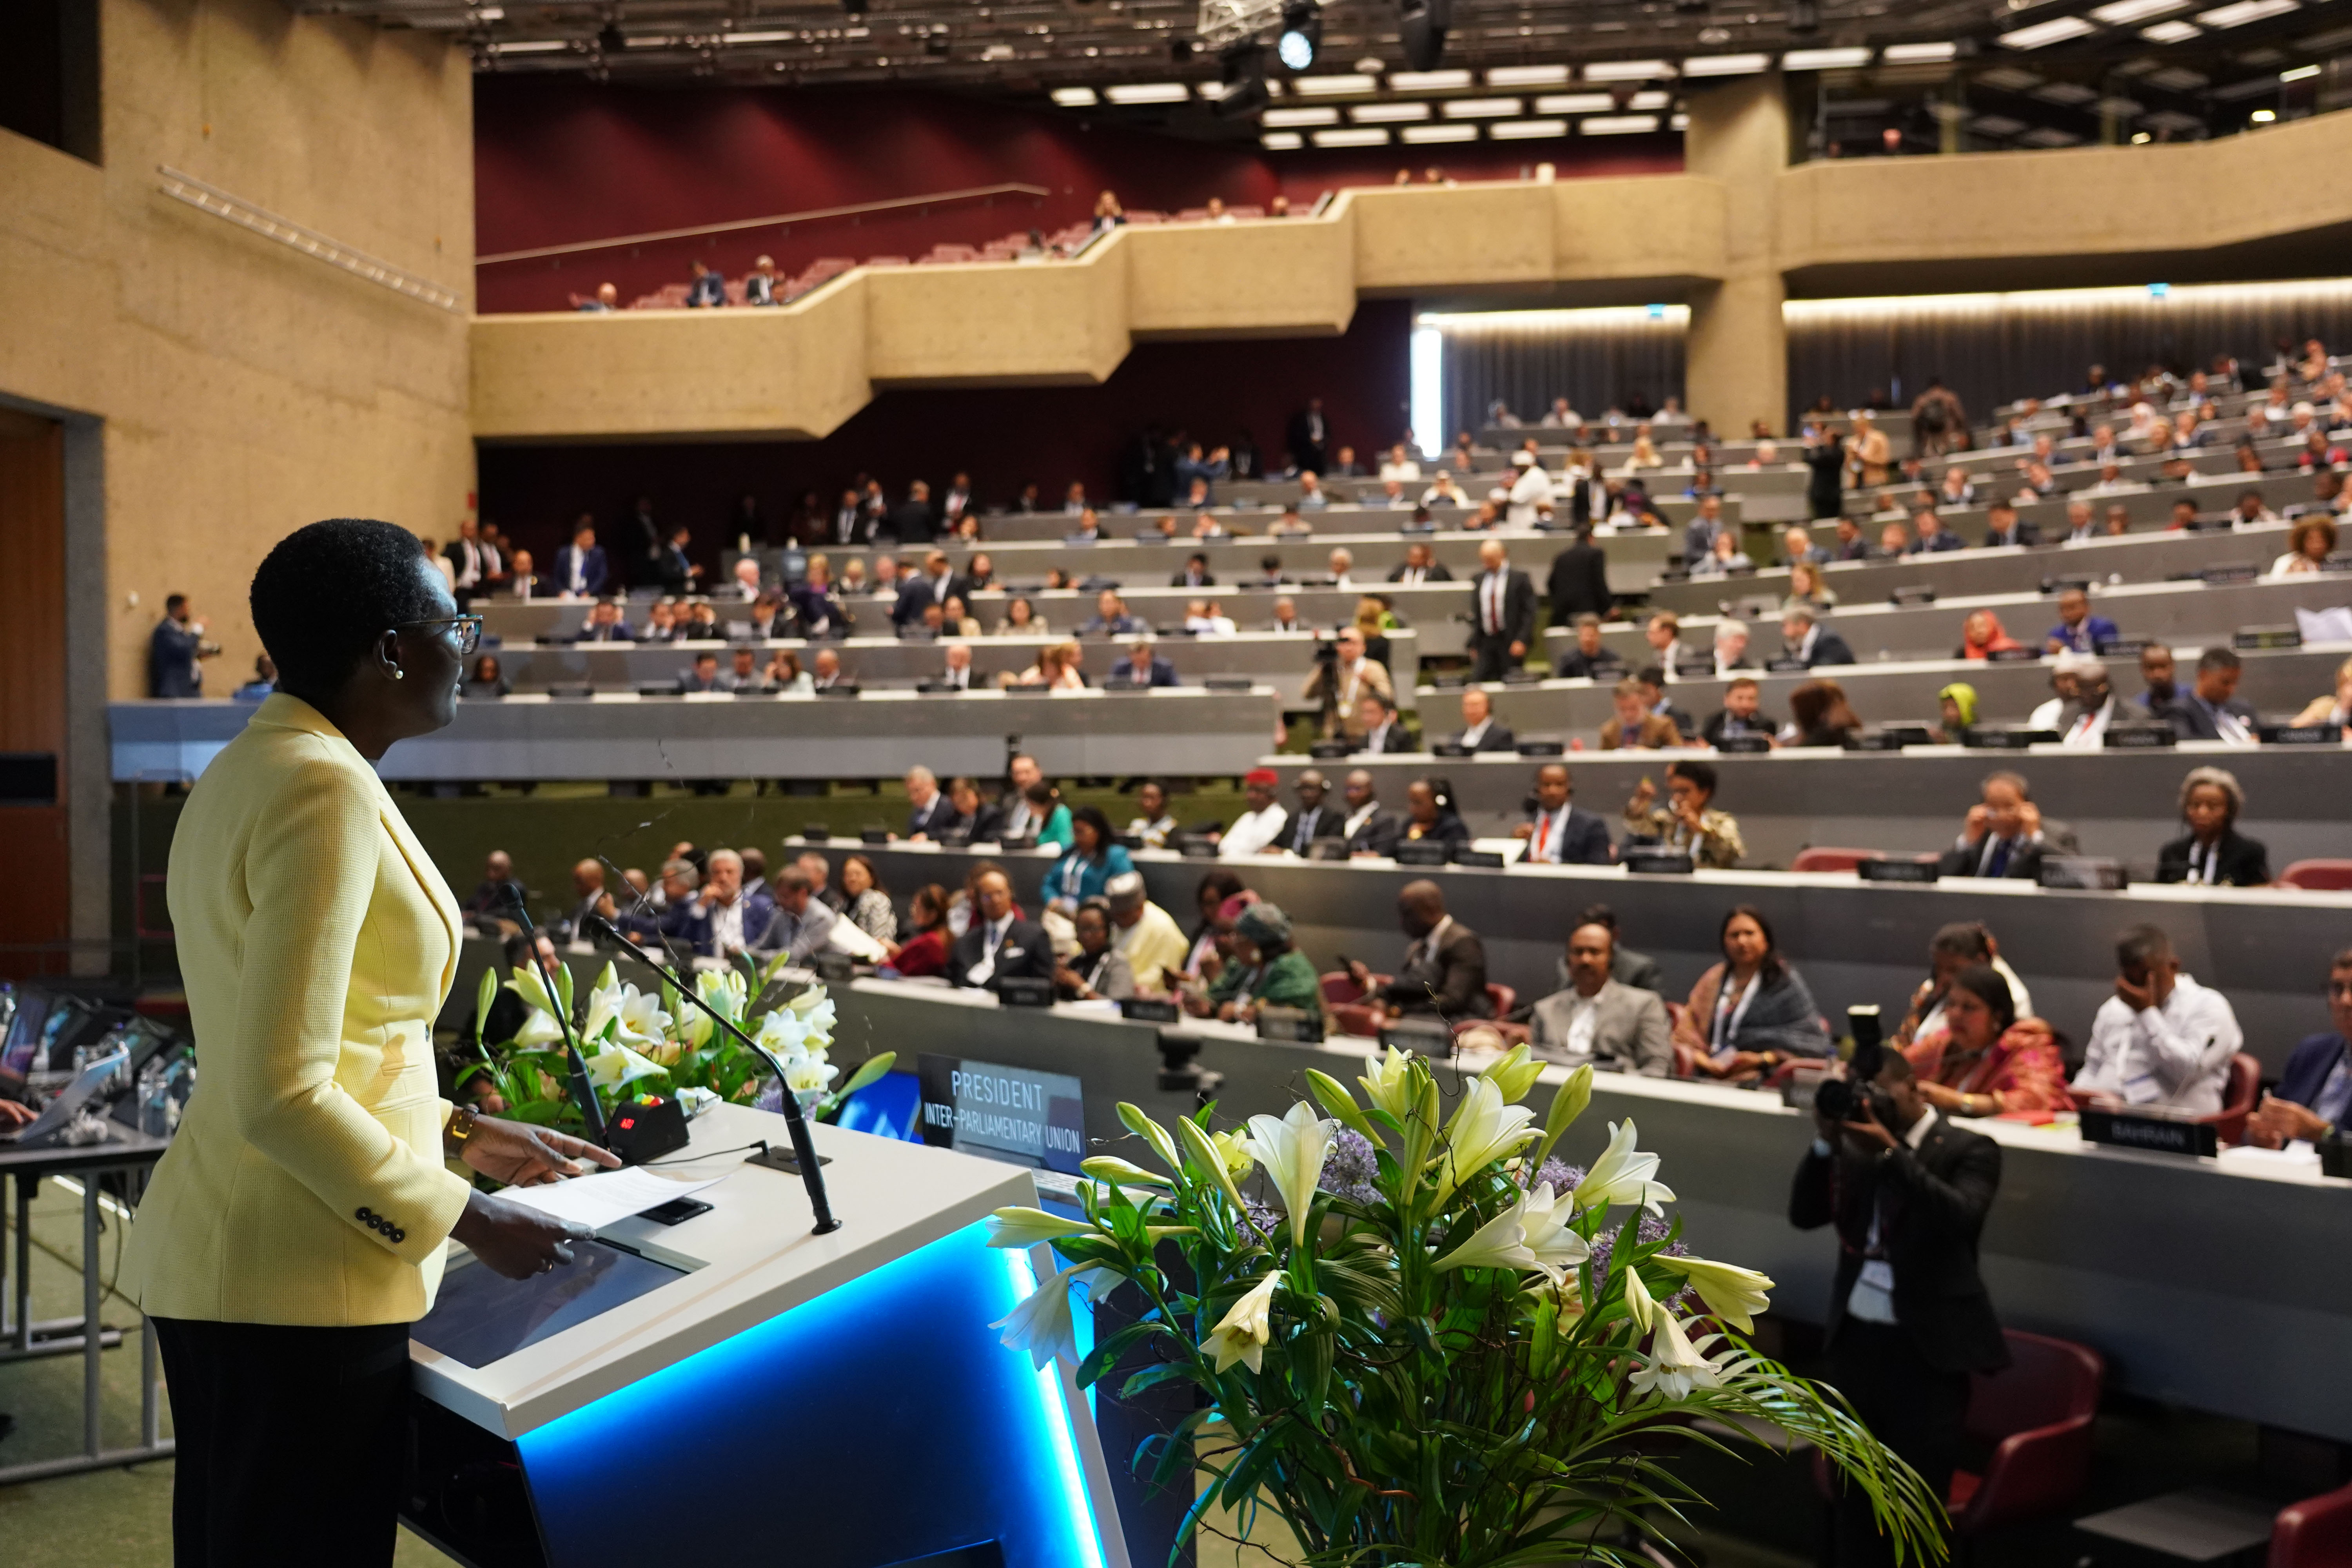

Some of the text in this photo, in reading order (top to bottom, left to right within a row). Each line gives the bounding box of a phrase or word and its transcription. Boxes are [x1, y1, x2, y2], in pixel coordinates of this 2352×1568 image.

[951, 1071, 1042, 1111] PRESIDENT
[924, 1102, 1080, 1154] INTER-PARLIAMENTARY UNION
